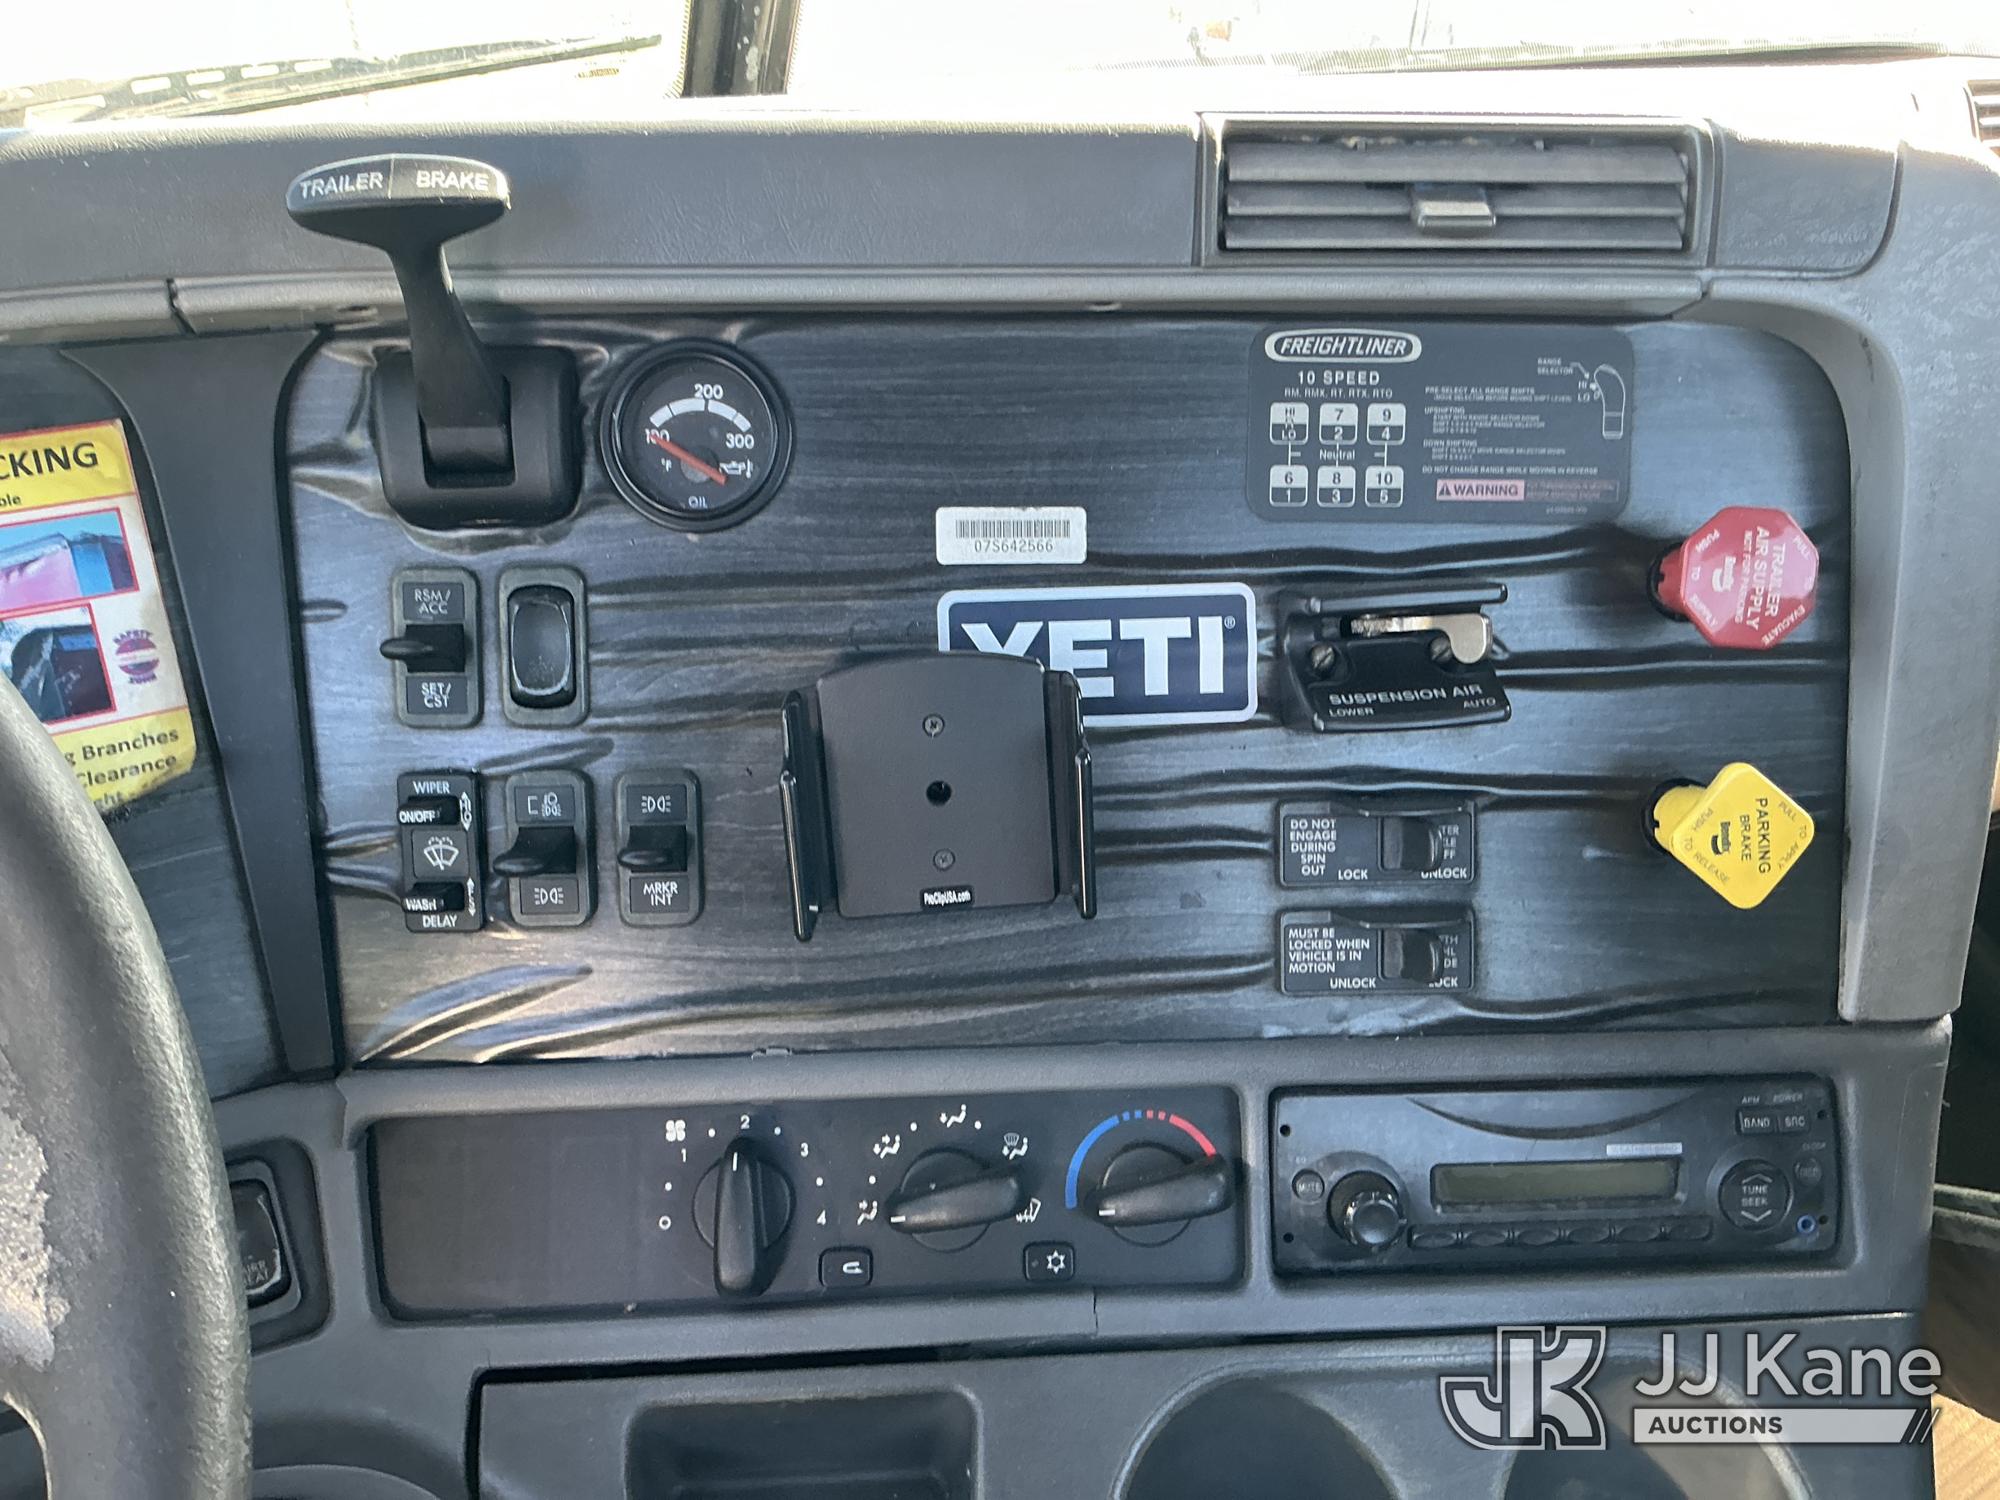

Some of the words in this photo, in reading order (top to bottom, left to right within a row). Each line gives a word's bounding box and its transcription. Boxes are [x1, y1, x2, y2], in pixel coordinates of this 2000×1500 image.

[300, 172, 384, 199] TRAILER
[416, 170, 489, 191] BRAKE
[1281, 336, 1407, 355] FREIGHTLINER
[1298, 371, 1315, 385] 10
[1323, 370, 1380, 385] SPEED
[694, 384, 724, 399] 200
[1335, 408, 1343, 421] 7
[1382, 408, 1391, 422] 9
[1334, 427, 1343, 440] 2
[1382, 427, 1390, 440] 4
[726, 433, 755, 449] 300
[1320, 450, 1356, 460] Neutral
[1285, 472, 1293, 484] 6
[1332, 472, 1341, 484] 8
[1376, 472, 1392, 485] 10
[1286, 490, 1291, 503] 1
[1332, 490, 1340, 503] 3
[1454, 484, 1518, 496] WARNING
[688, 496, 708, 509] OIL
[974, 540, 1053, 553] 07S642566
[1756, 526, 1770, 556] AIR
[1765, 543, 1785, 616] TRAILER
[414, 588, 451, 602] RSM/
[1735, 575, 1749, 623] PARKING
[1746, 560, 1767, 630] SUPPLY
[418, 603, 448, 615] ACC
[1761, 604, 1805, 645] EVACUATE
[961, 615, 1224, 698] YETI
[421, 682, 452, 697] SET/
[1329, 687, 1447, 706] SUSPENSION
[1453, 683, 1483, 698] AIR
[423, 696, 450, 709] CST
[1463, 697, 1496, 710] AUTO
[1328, 707, 1375, 718] LOWER
[82, 730, 179, 760] Branches
[412, 781, 451, 794] WIPER
[399, 810, 435, 823] ON/OFF
[1778, 801, 1796, 821] PULL
[1290, 819, 1308, 829] DO
[1311, 819, 1336, 829] NOT
[1692, 808, 1713, 832] PUSH
[1290, 831, 1337, 841] ENGAGE
[1740, 814, 1752, 861] BRAKE
[1755, 798, 1772, 873] PARKING
[1291, 842, 1336, 853] DURING
[1300, 854, 1326, 864] SPIN
[1301, 865, 1326, 876] OUT
[1421, 867, 1467, 879] UNLOCK
[1693, 852, 1730, 883] RELEASE
[1338, 870, 1368, 880] LOCK
[643, 881, 678, 895] MRKR
[405, 899, 437, 911] WASH
[650, 894, 673, 906] INT
[422, 915, 458, 928] DELAY
[1288, 928, 1320, 938] MUST
[1322, 928, 1335, 938] BE
[1289, 939, 1332, 950] LOCKED
[1336, 938, 1370, 949] WHEN
[1289, 951, 1333, 962] VEHICLE
[1336, 951, 1346, 961] IS
[1349, 951, 1362, 961] IN
[1289, 962, 1336, 973] MOTION
[1330, 978, 1376, 988] UNLOCK
[1428, 977, 1458, 988] OCK
[740, 1115, 751, 1130] 2
[1744, 1118, 1770, 1128] BAND
[681, 1148, 687, 1163] 1
[800, 1142, 810, 1157] 3
[1742, 1185, 1768, 1194] TUNE
[1742, 1197, 1769, 1207] SEEK
[817, 1210, 827, 1226] 4
